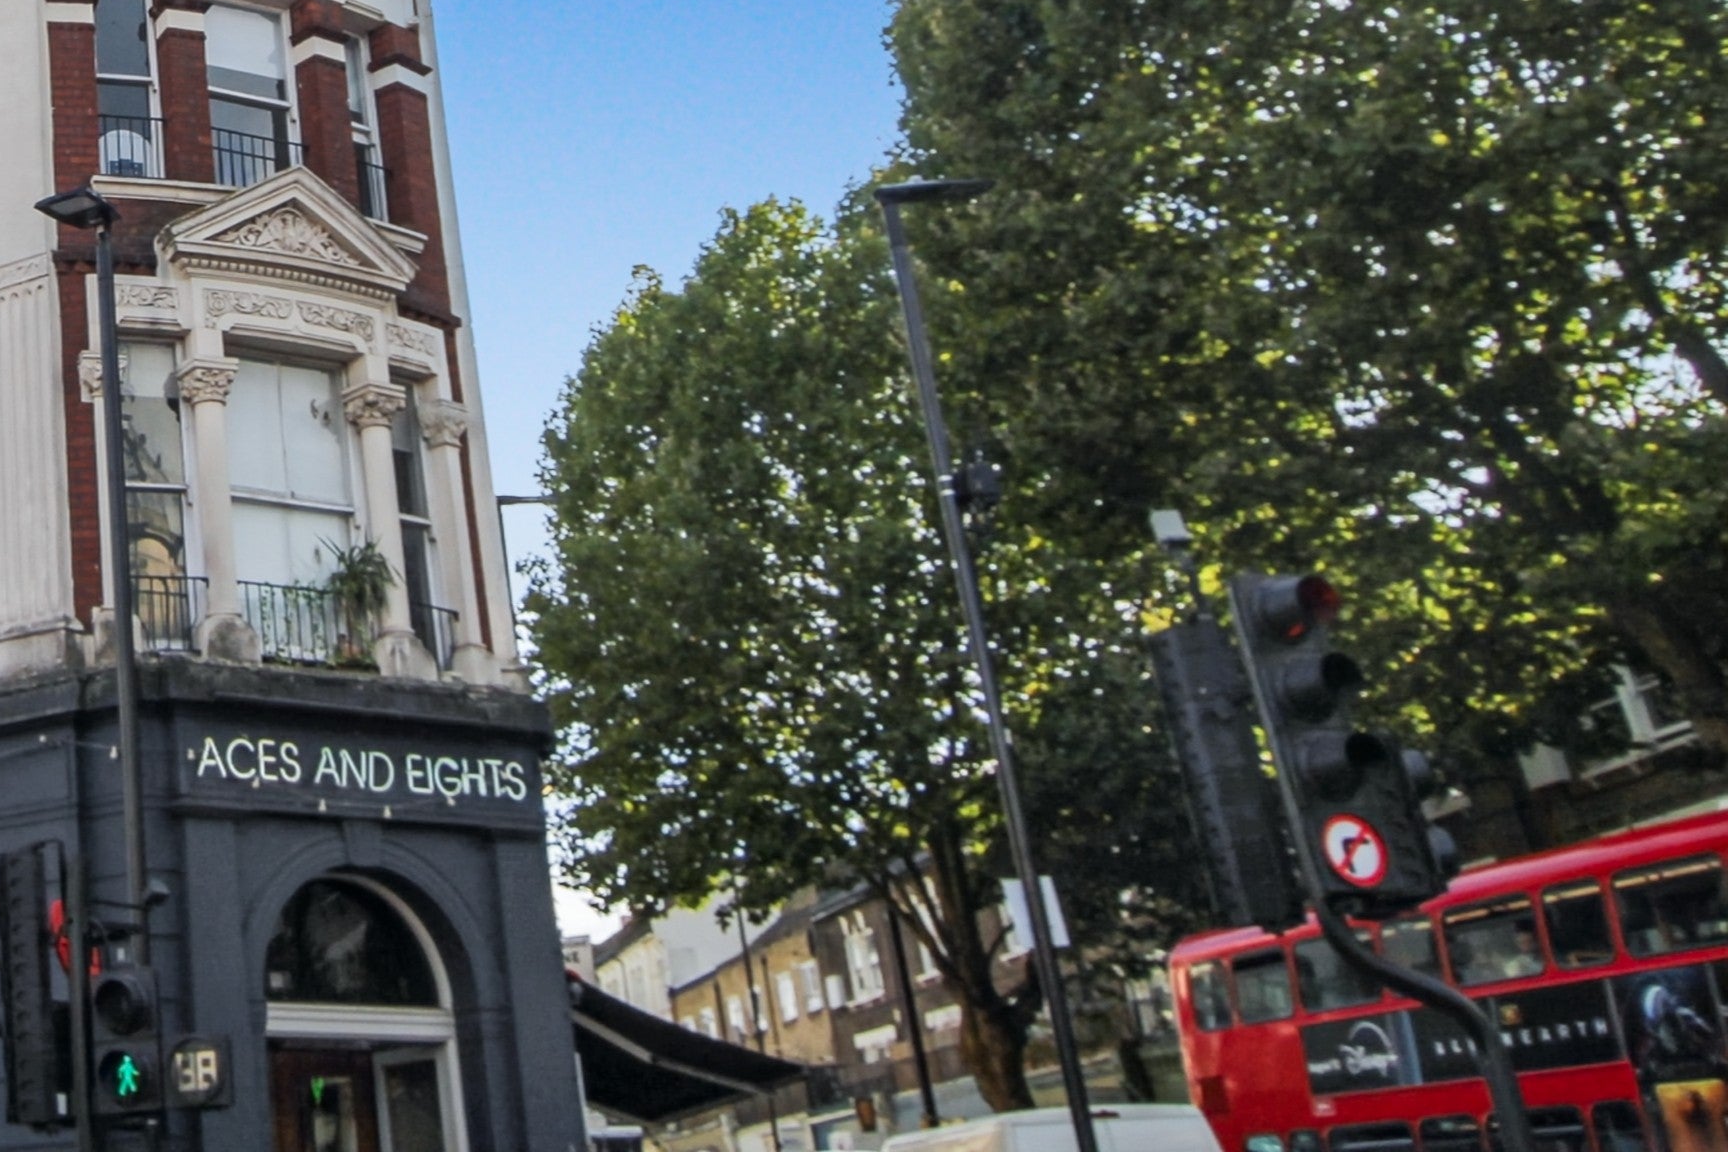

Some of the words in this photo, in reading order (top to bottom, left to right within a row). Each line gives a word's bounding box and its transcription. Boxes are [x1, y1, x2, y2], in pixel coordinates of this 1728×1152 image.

[197, 737, 302, 783] ACES
[314, 747, 395, 793] AND
[406, 754, 527, 801] EIGHTS
